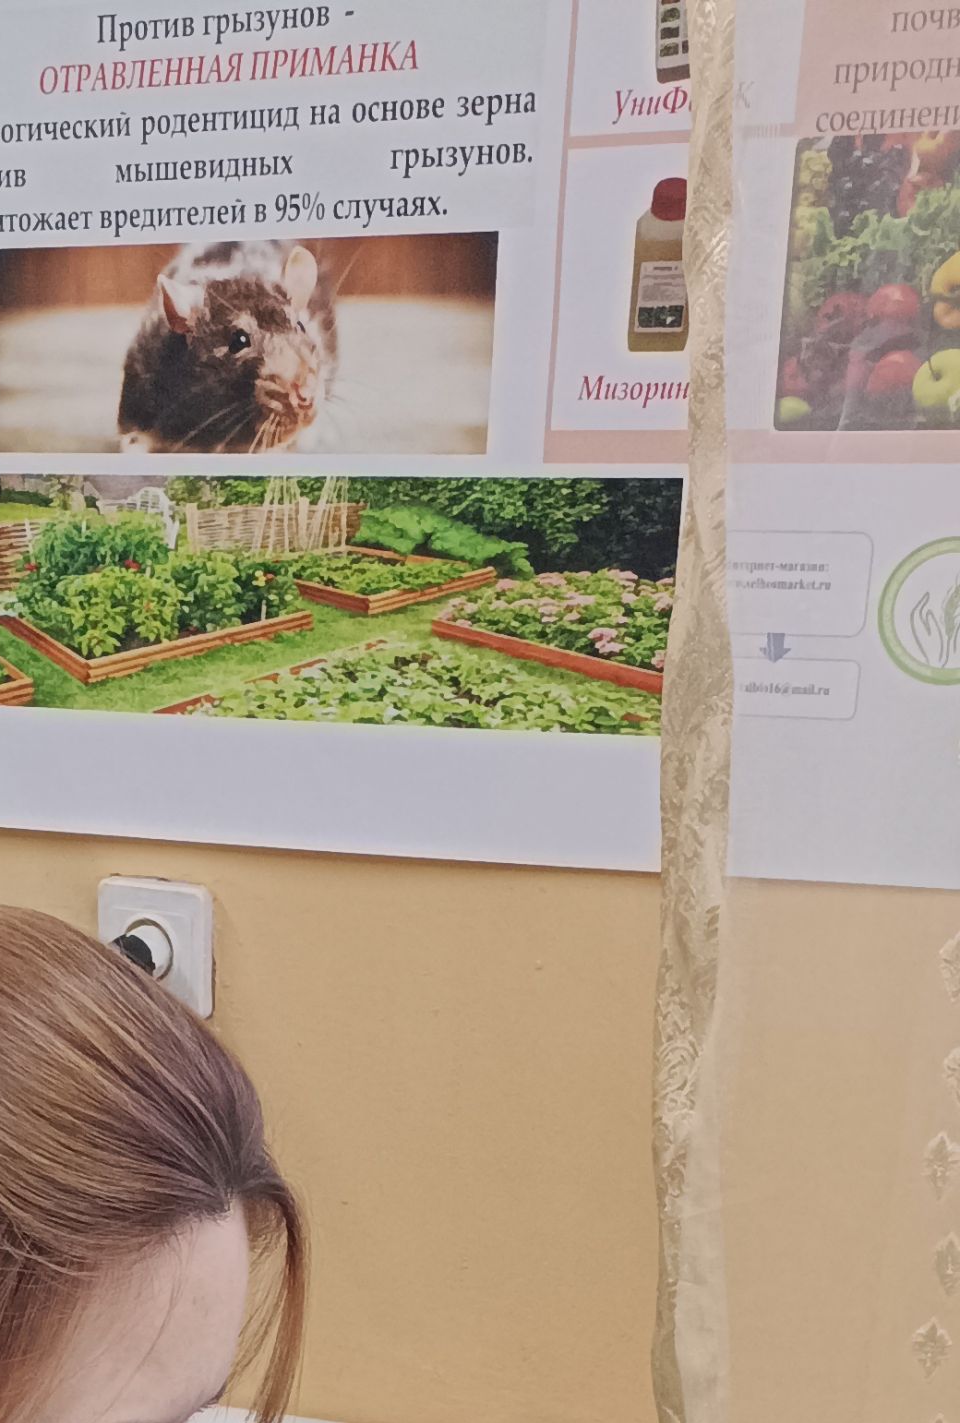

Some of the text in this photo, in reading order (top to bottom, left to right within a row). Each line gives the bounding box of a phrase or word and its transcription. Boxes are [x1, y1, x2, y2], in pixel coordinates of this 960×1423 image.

[97, 14, 195, 52] Против
[202, 5, 330, 45] грызунов
[39, 40, 420, 95] ОТРАВЛЕННАЯ ПРИМАНКА
[141, 106, 300, 145] родентицид
[310, 102, 341, 126] на
[352, 97, 445, 123] основе
[456, 91, 537, 126] зерна
[115, 155, 293, 184] мышевидных
[390, 141, 534, 179] грызунов.
[99, 198, 246, 238] вредителей
[254, 202, 267, 224] в
[275, 191, 325, 223] 95%
[333, 195, 448, 229] случаях.
